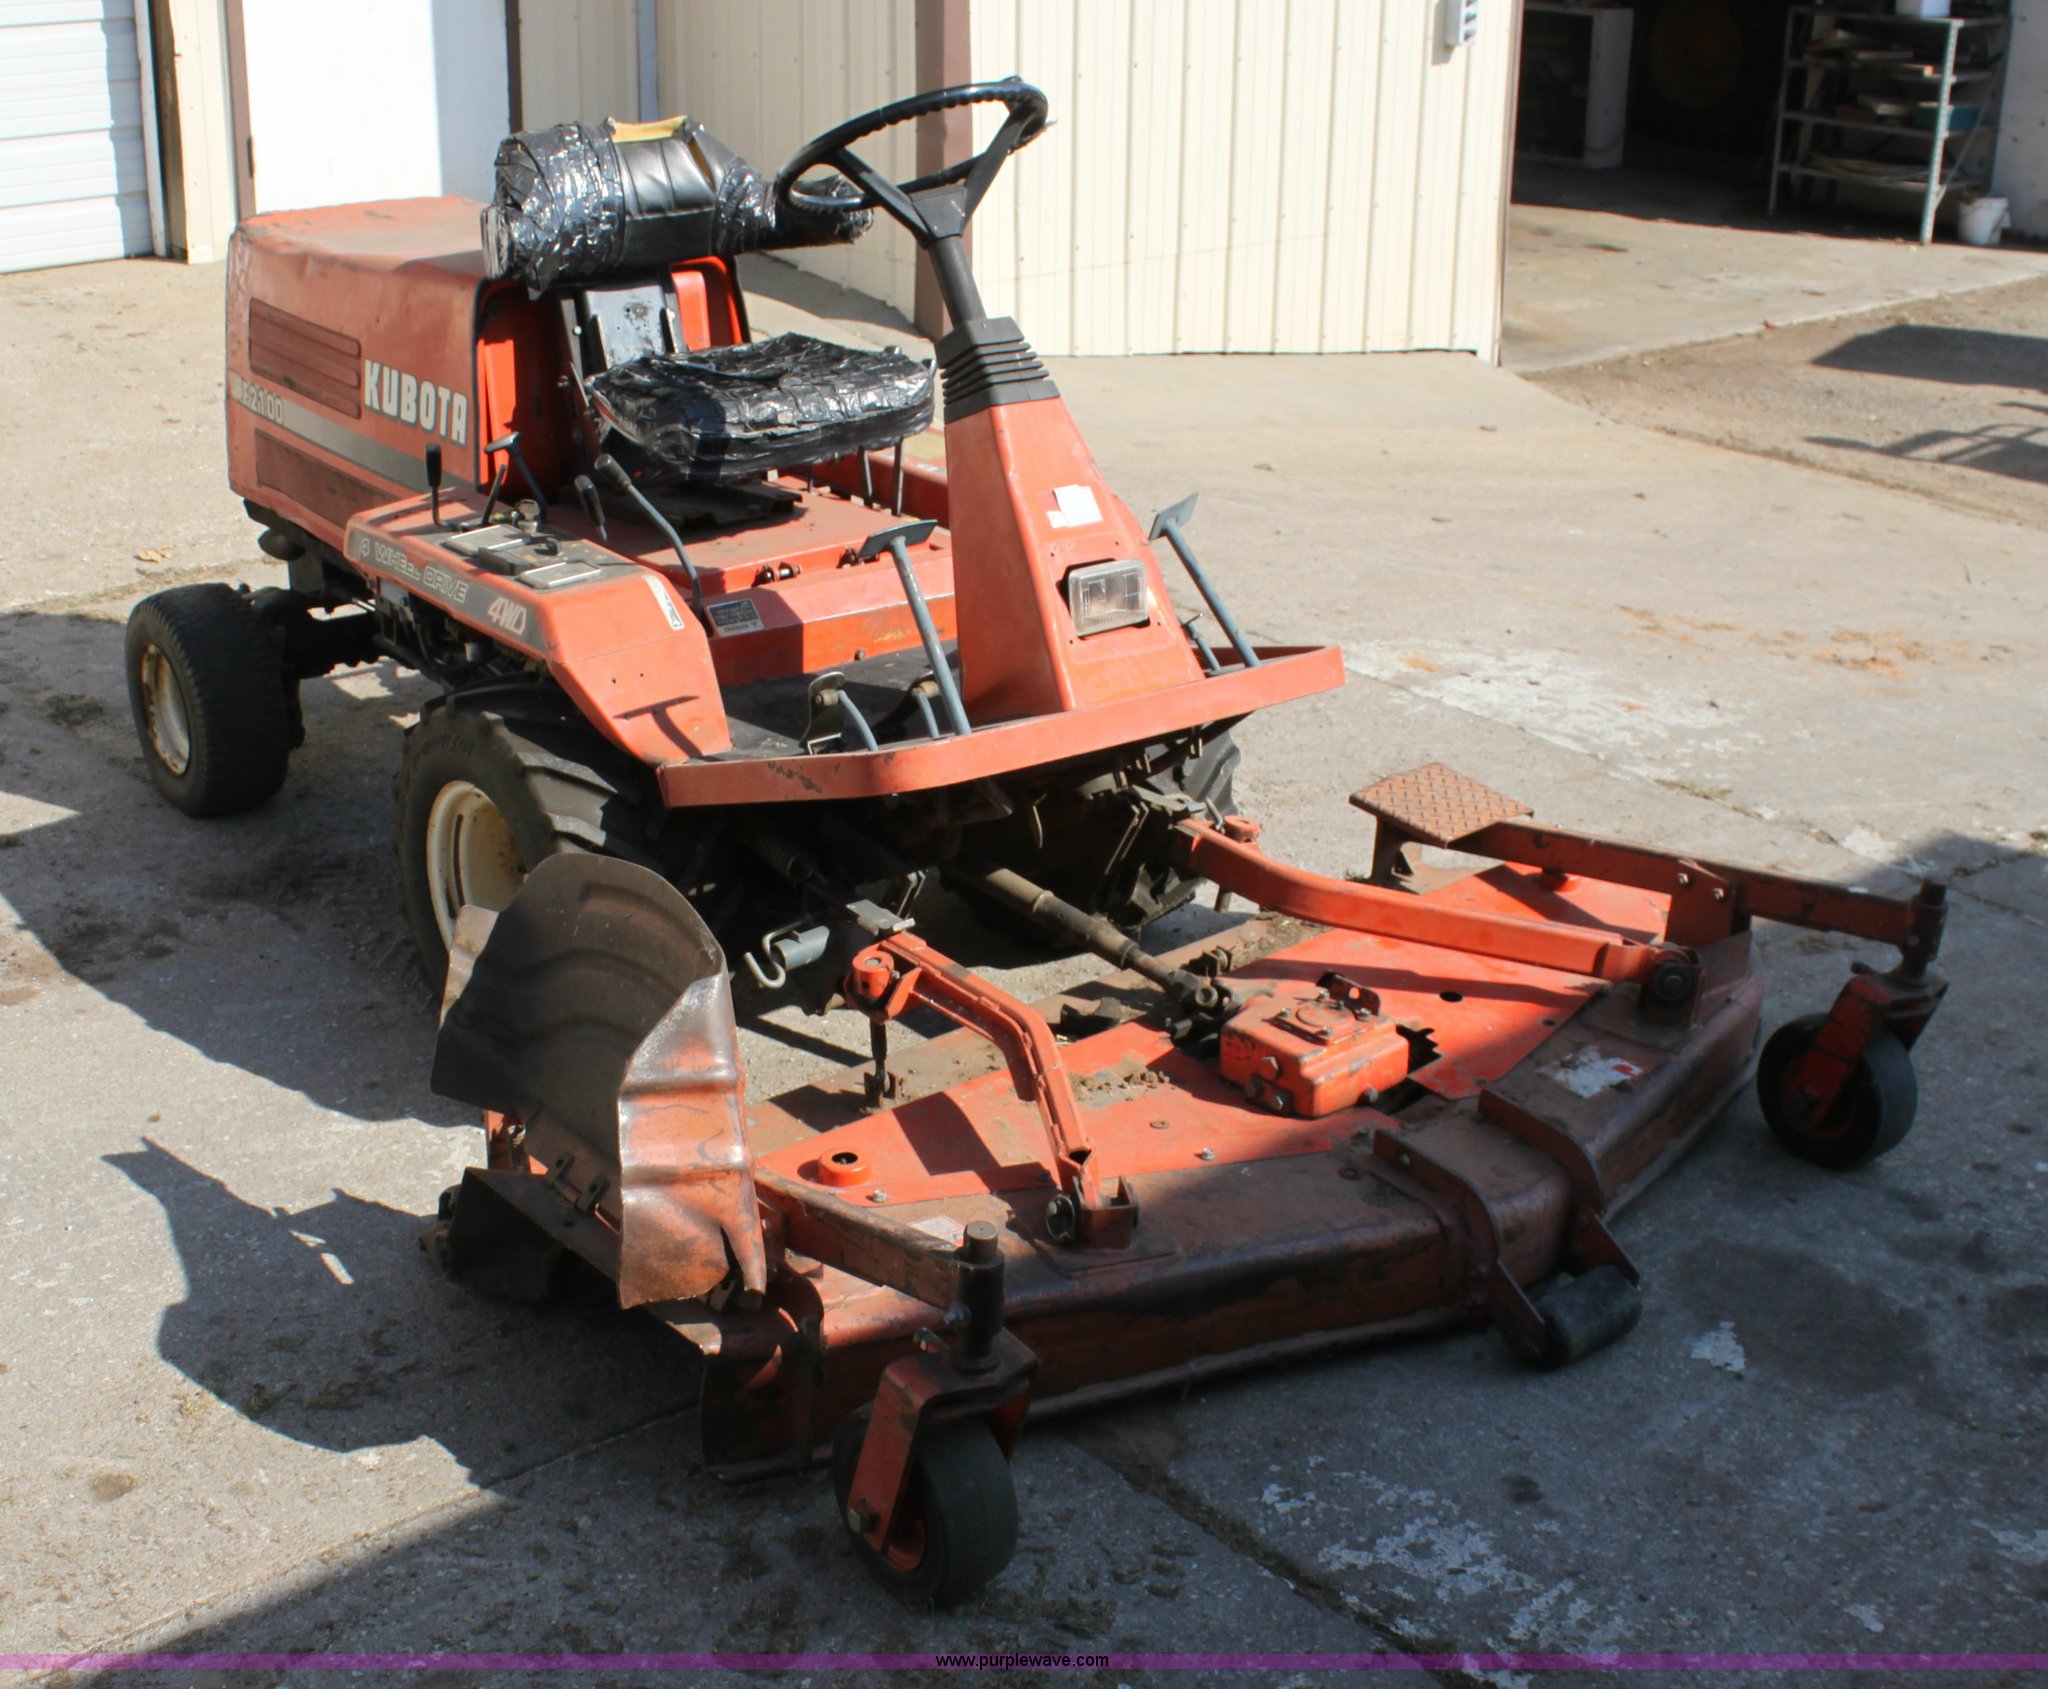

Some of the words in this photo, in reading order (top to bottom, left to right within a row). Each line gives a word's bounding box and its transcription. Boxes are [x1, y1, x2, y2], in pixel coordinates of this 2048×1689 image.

[364, 359, 468, 446] KUBOTA
[374, 540, 421, 581] WHEEL
[423, 565, 469, 604] DRIVE
[488, 596, 527, 636] 4WD
